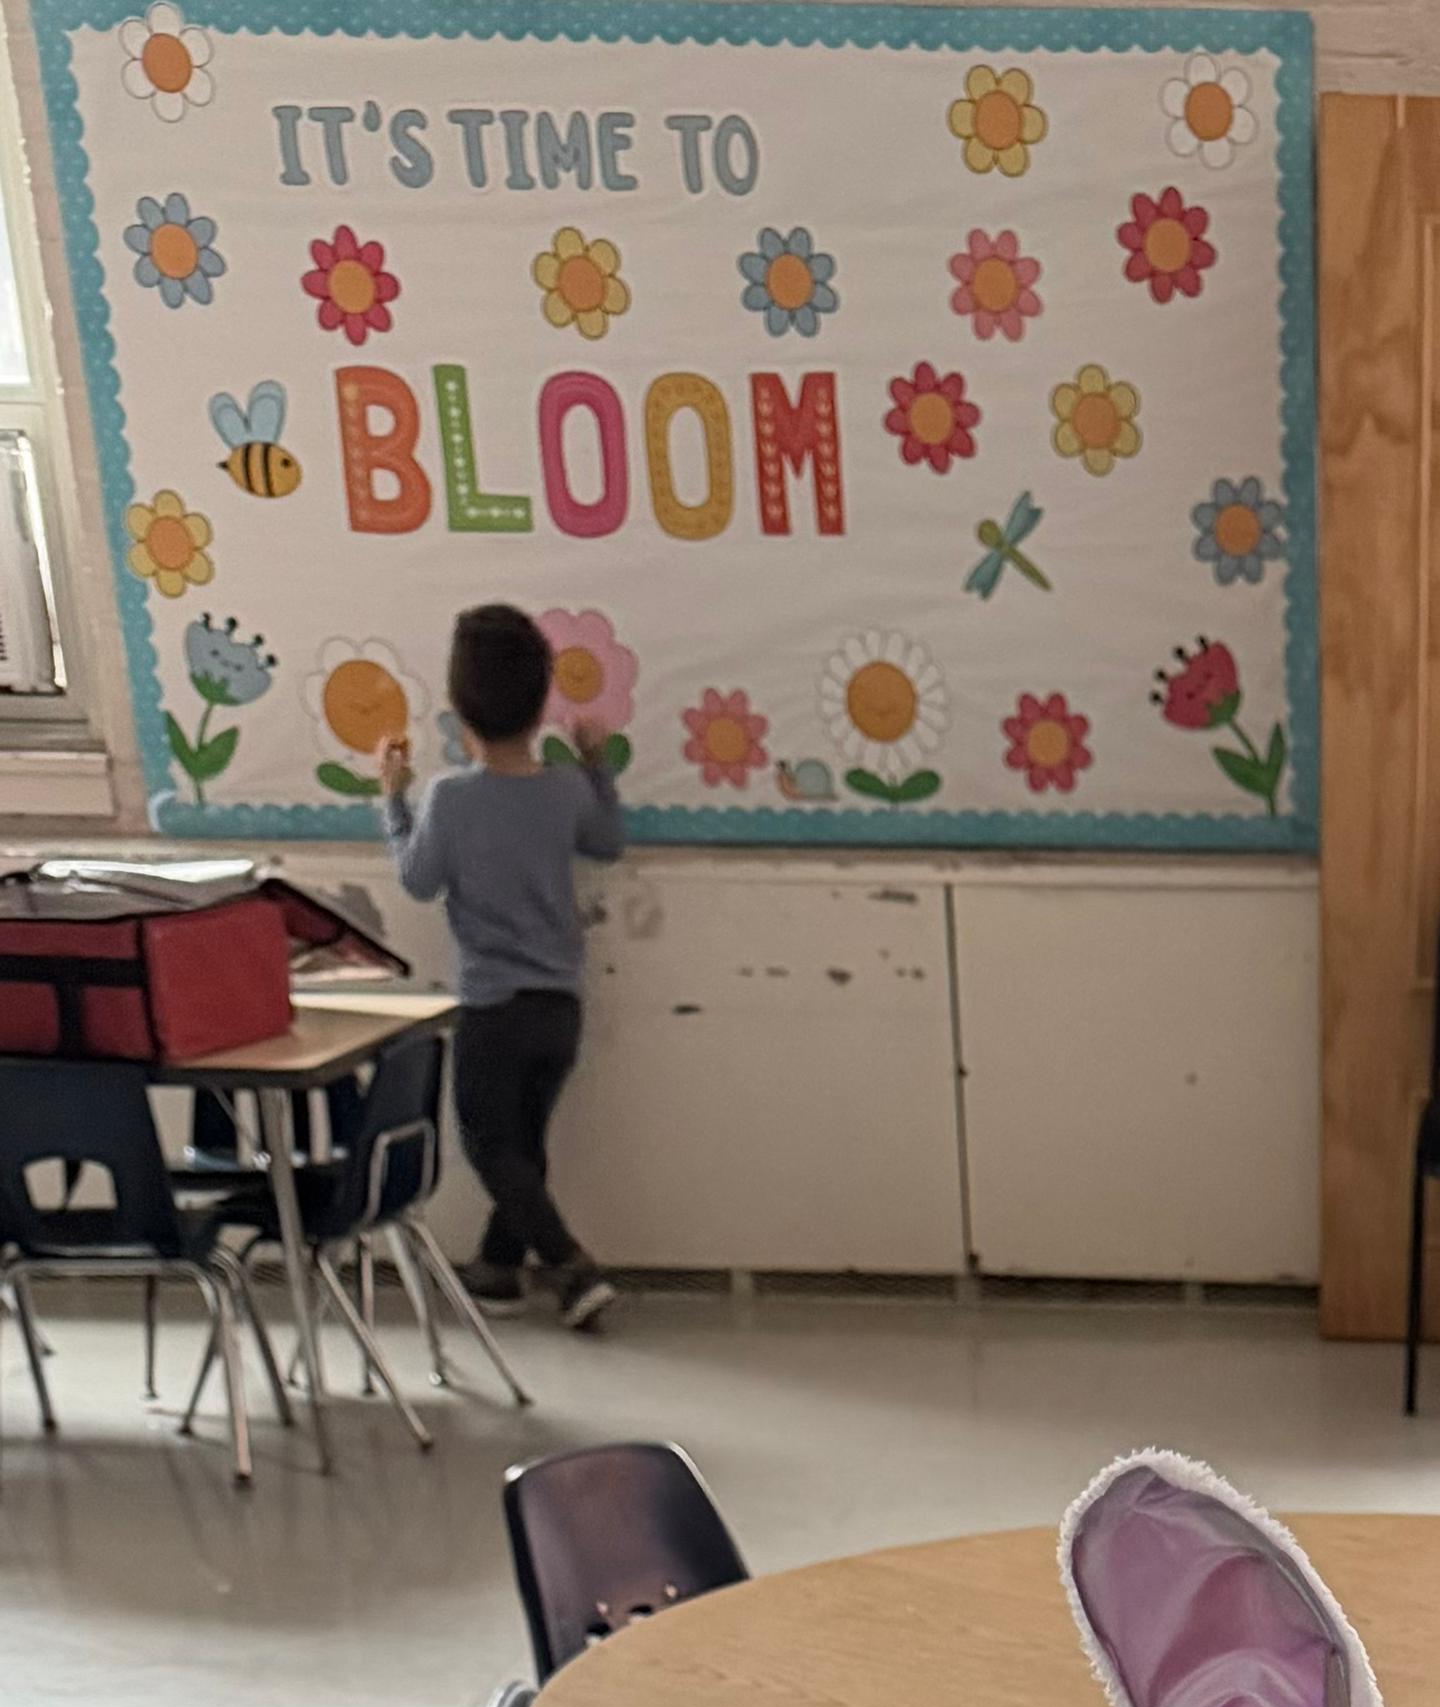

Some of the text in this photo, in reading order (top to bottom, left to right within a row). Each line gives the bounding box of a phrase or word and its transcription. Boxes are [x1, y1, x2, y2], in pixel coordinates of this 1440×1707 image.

[270, 100, 760, 197] IT'S TIME TO
[332, 363, 846, 542] BLOOM
